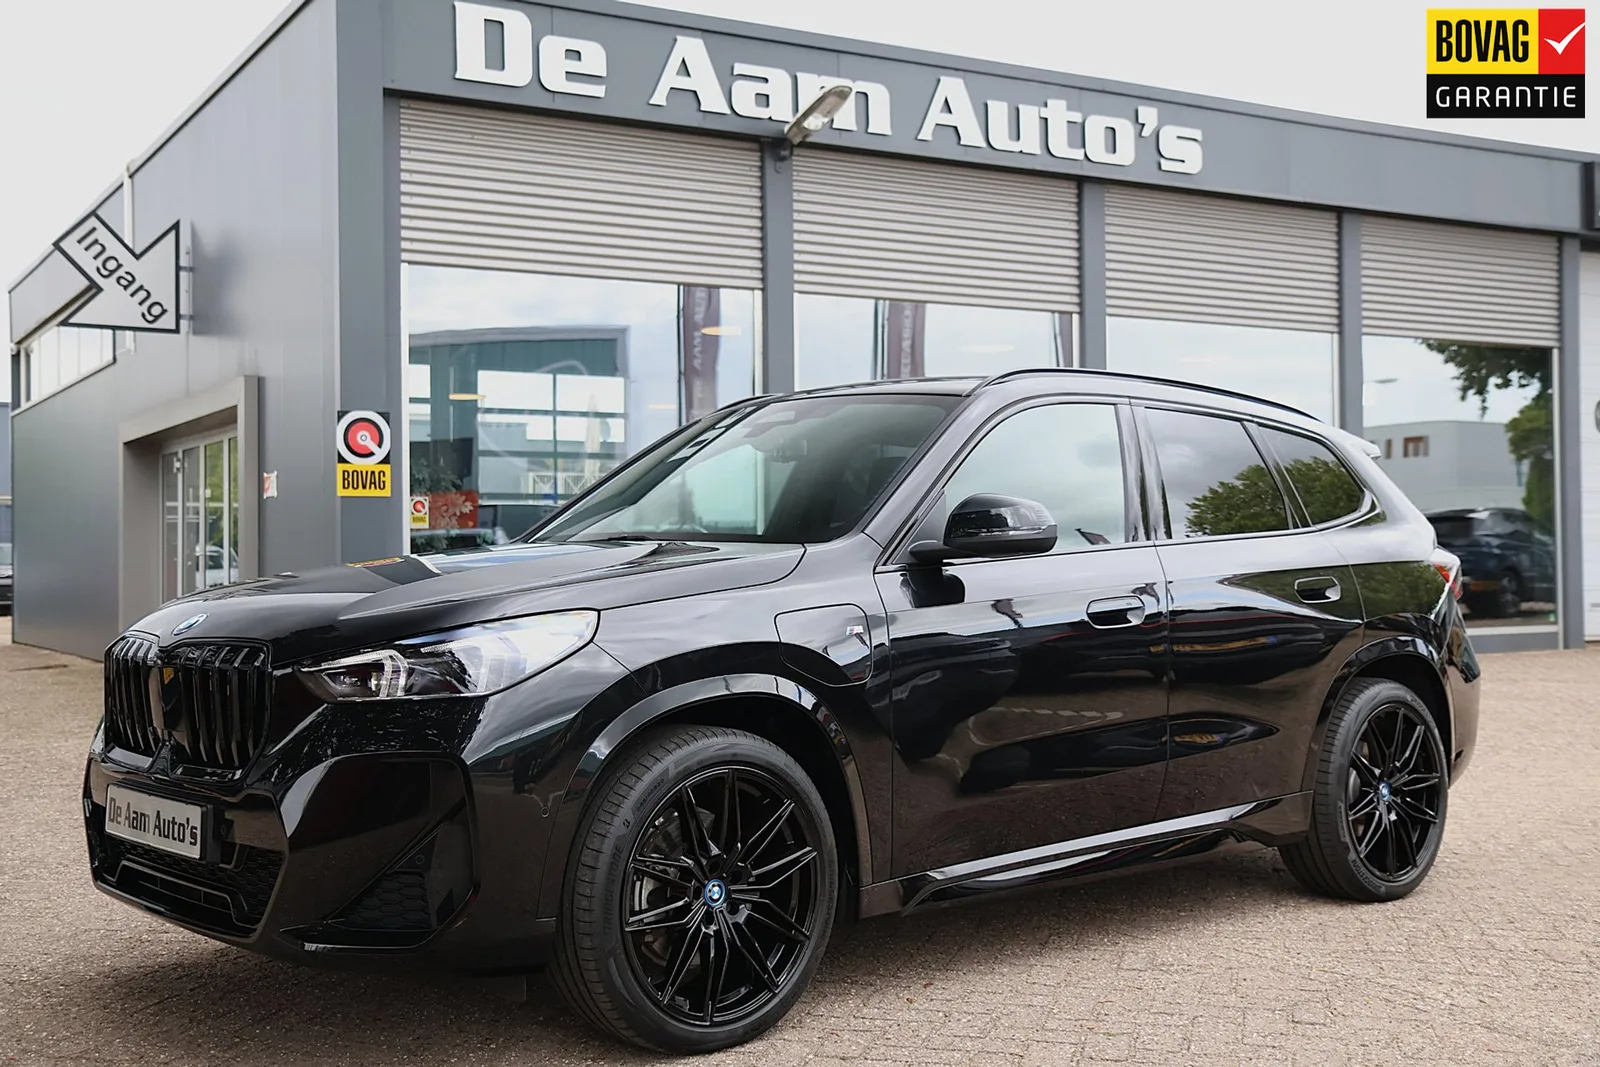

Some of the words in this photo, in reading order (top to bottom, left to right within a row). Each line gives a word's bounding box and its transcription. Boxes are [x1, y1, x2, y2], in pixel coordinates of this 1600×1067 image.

[454, 1, 607, 98] De
[648, 35, 892, 136] Aam
[917, 75, 1203, 174] Auto's
[76, 226, 169, 324] Ingang
[342, 469, 386, 491] BOVAG
[108, 796, 122, 825] De
[123, 801, 150, 833] Aam
[152, 809, 198, 846] Auto's
